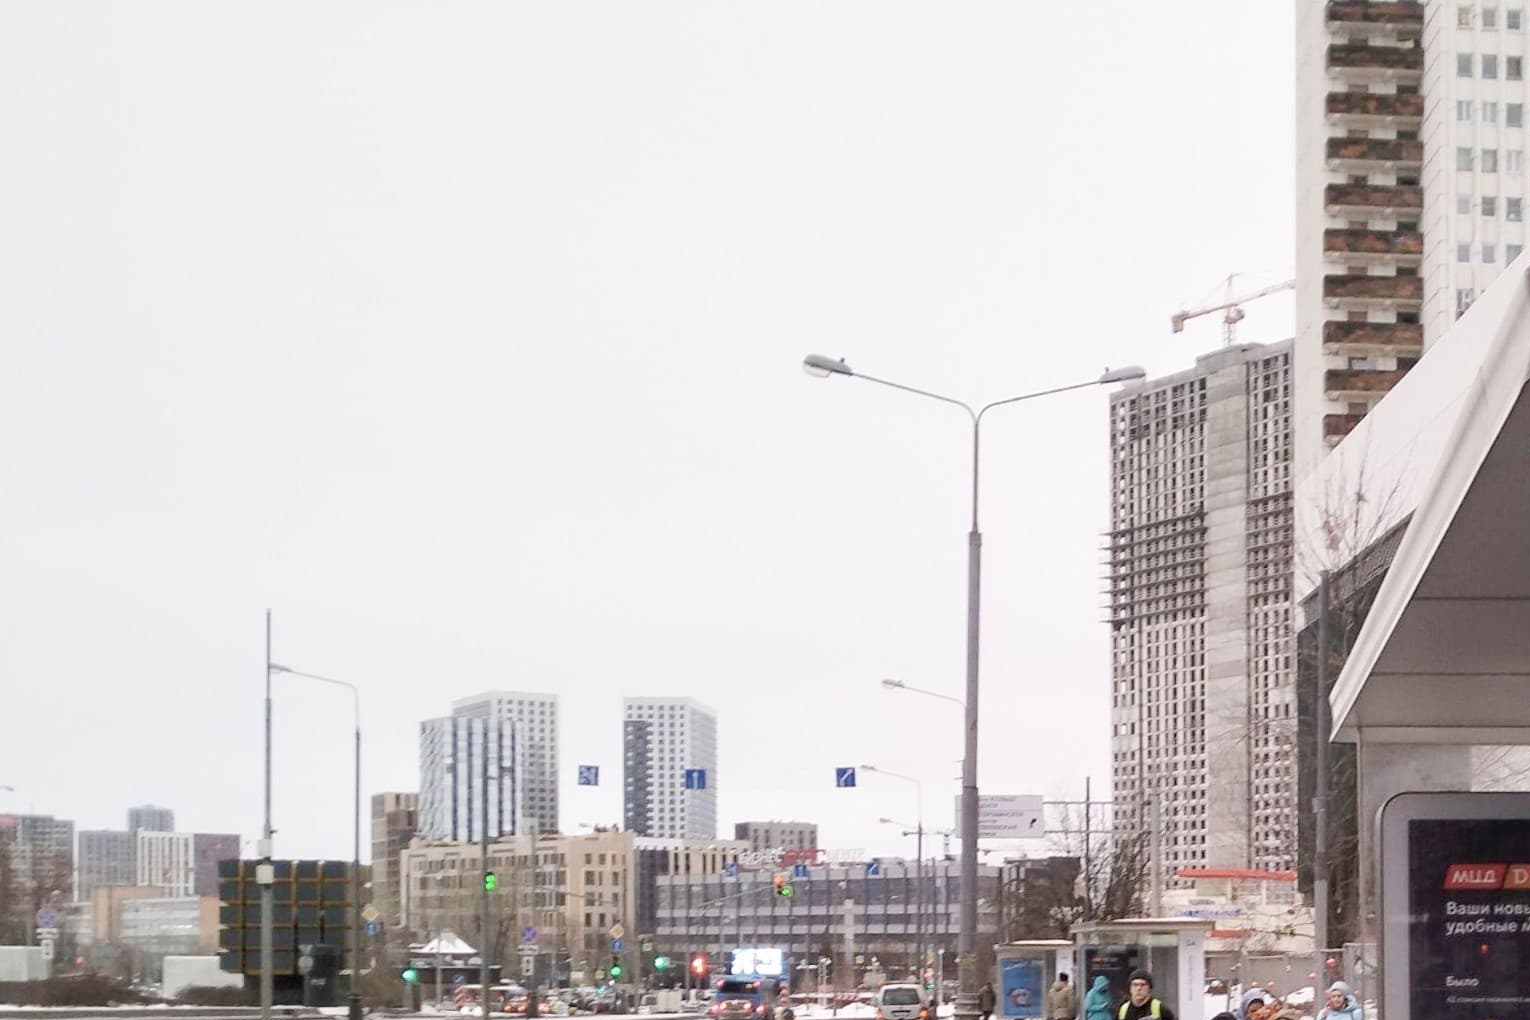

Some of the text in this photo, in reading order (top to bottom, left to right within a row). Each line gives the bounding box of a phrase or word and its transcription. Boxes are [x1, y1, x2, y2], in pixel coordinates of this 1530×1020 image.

[1452, 869, 1496, 884] МЦД
[1445, 901, 1490, 915] Ваши
[1445, 918, 1518, 936] удобные
[1446, 976, 1480, 988] Было
